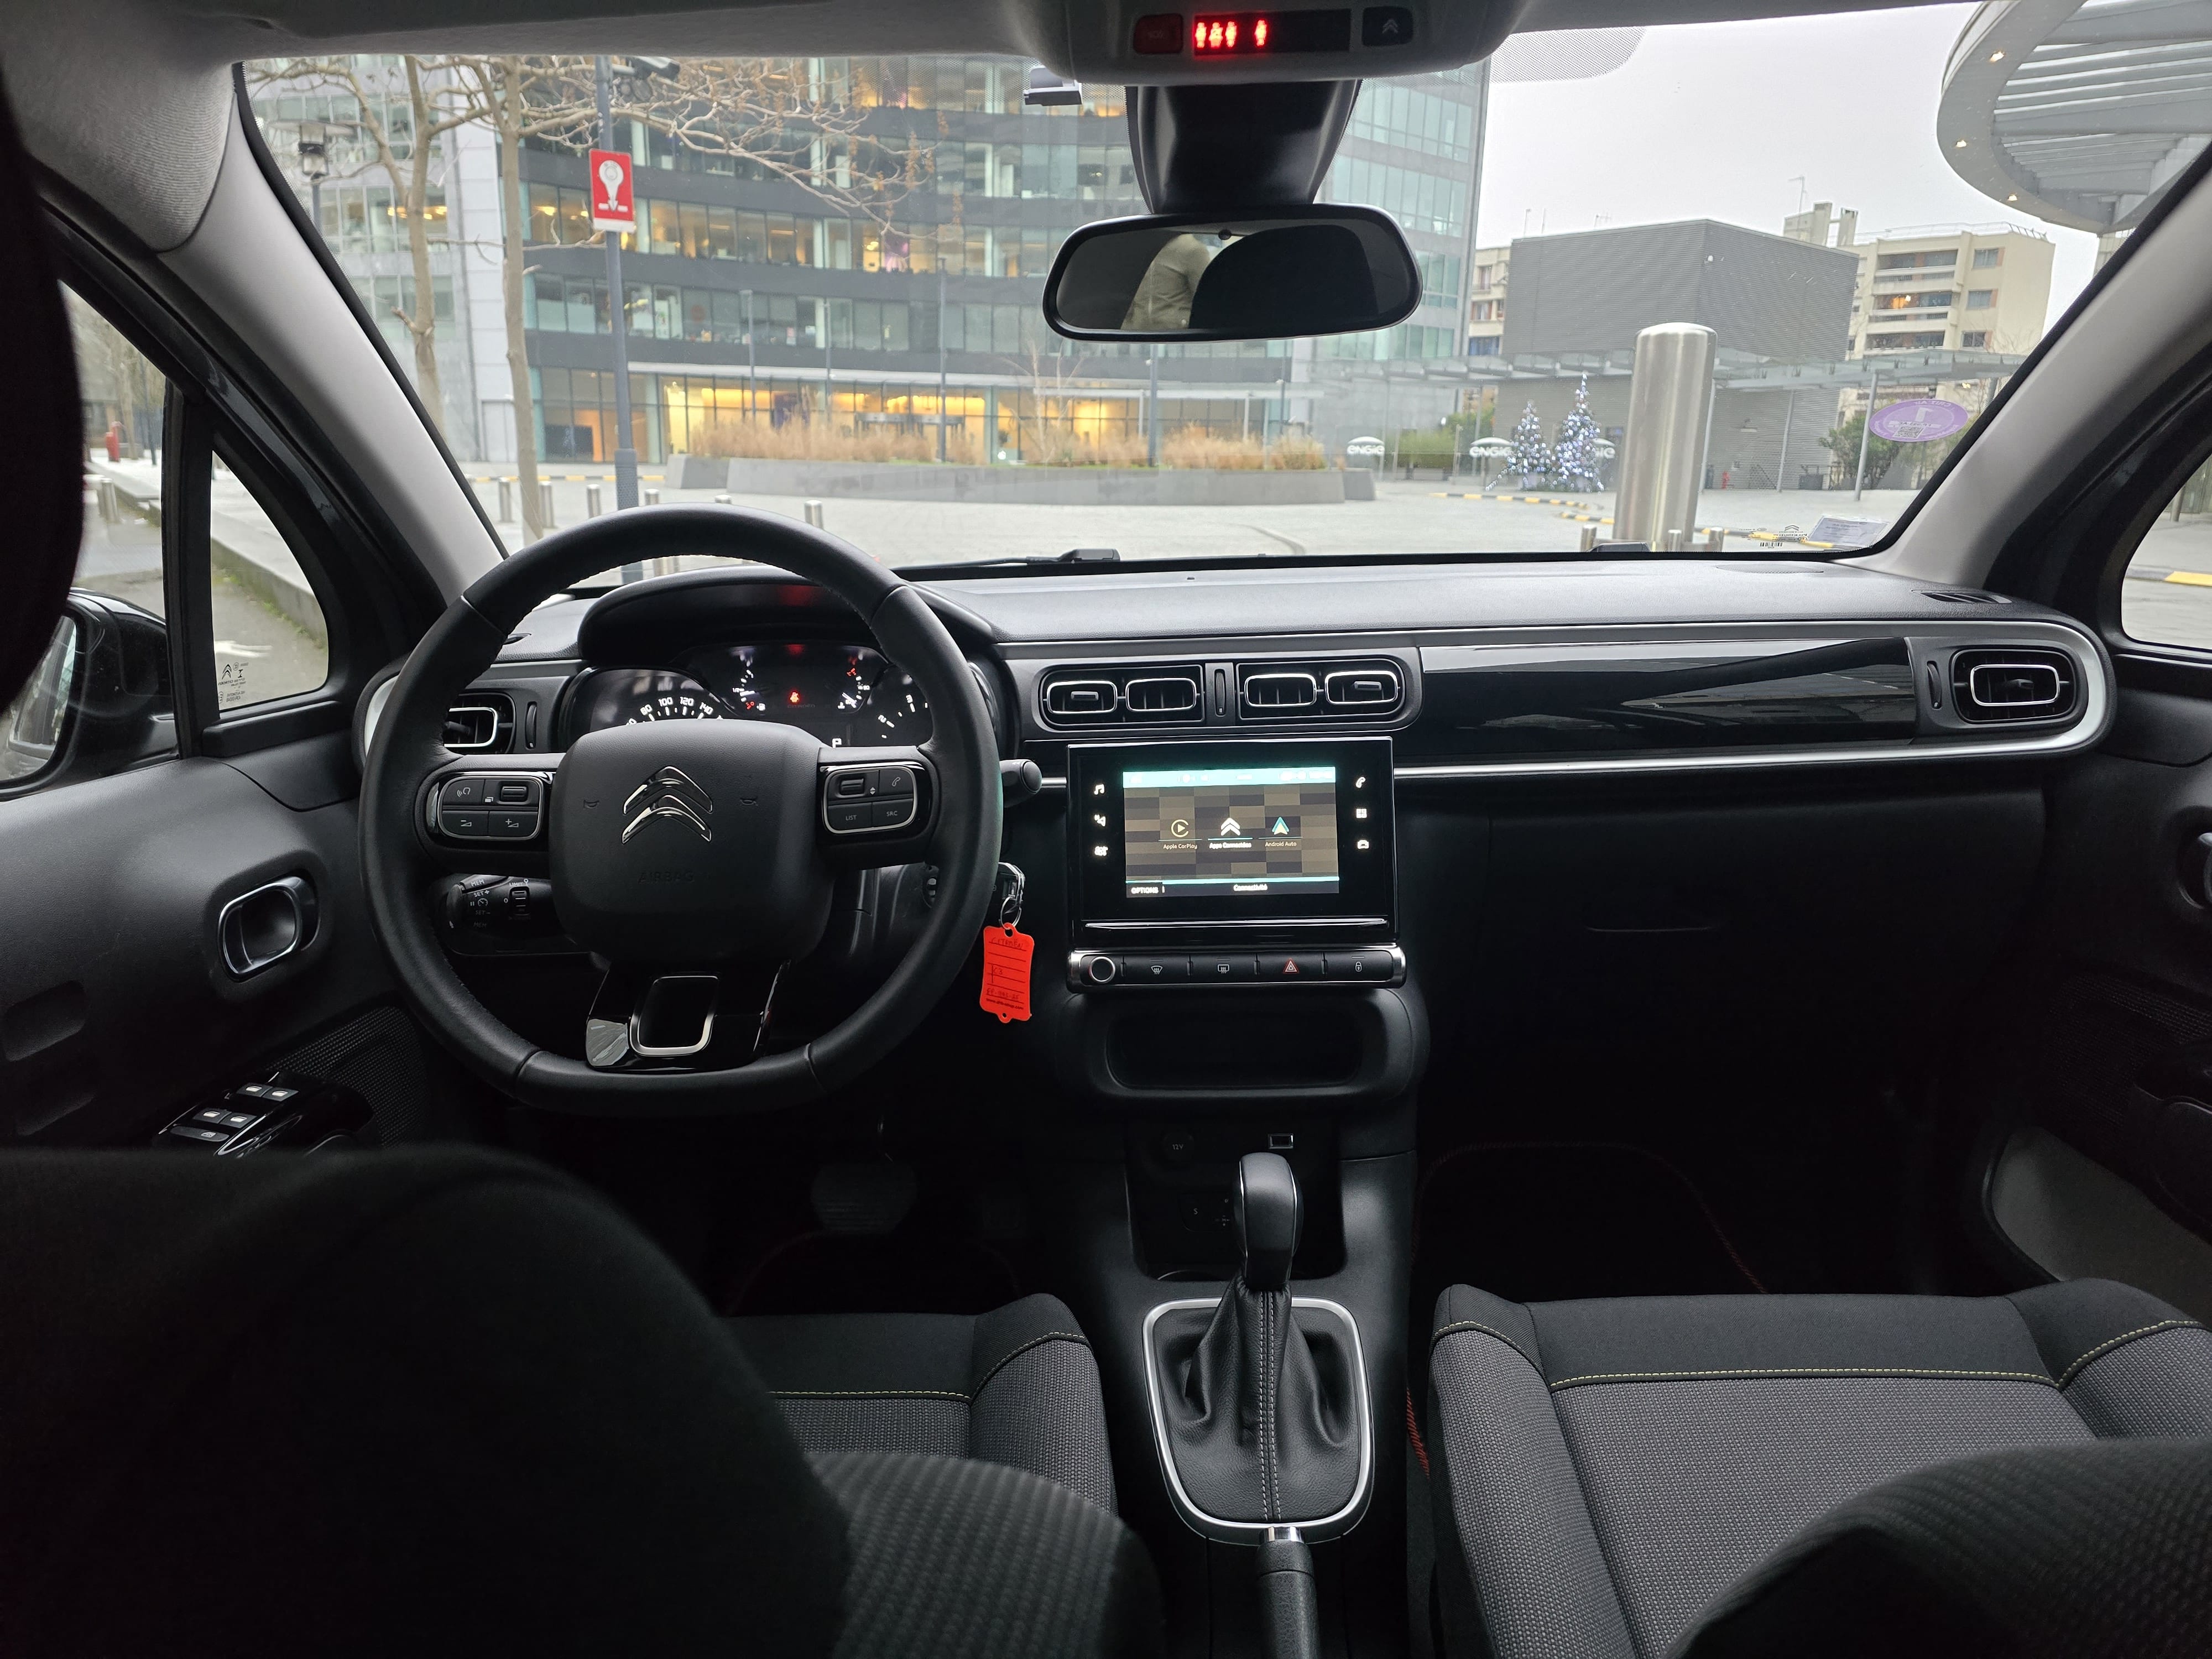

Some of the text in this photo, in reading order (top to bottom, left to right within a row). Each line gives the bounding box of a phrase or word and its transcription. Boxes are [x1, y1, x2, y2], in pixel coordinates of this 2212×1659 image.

[658, 697, 673, 707] 100
[680, 696, 694, 707] 120
[906, 694, 913, 703] 3
[640, 704, 653, 716] 80
[700, 702, 713, 715] 140
[878, 714, 887, 723] 2
[832, 738, 842, 748] P
